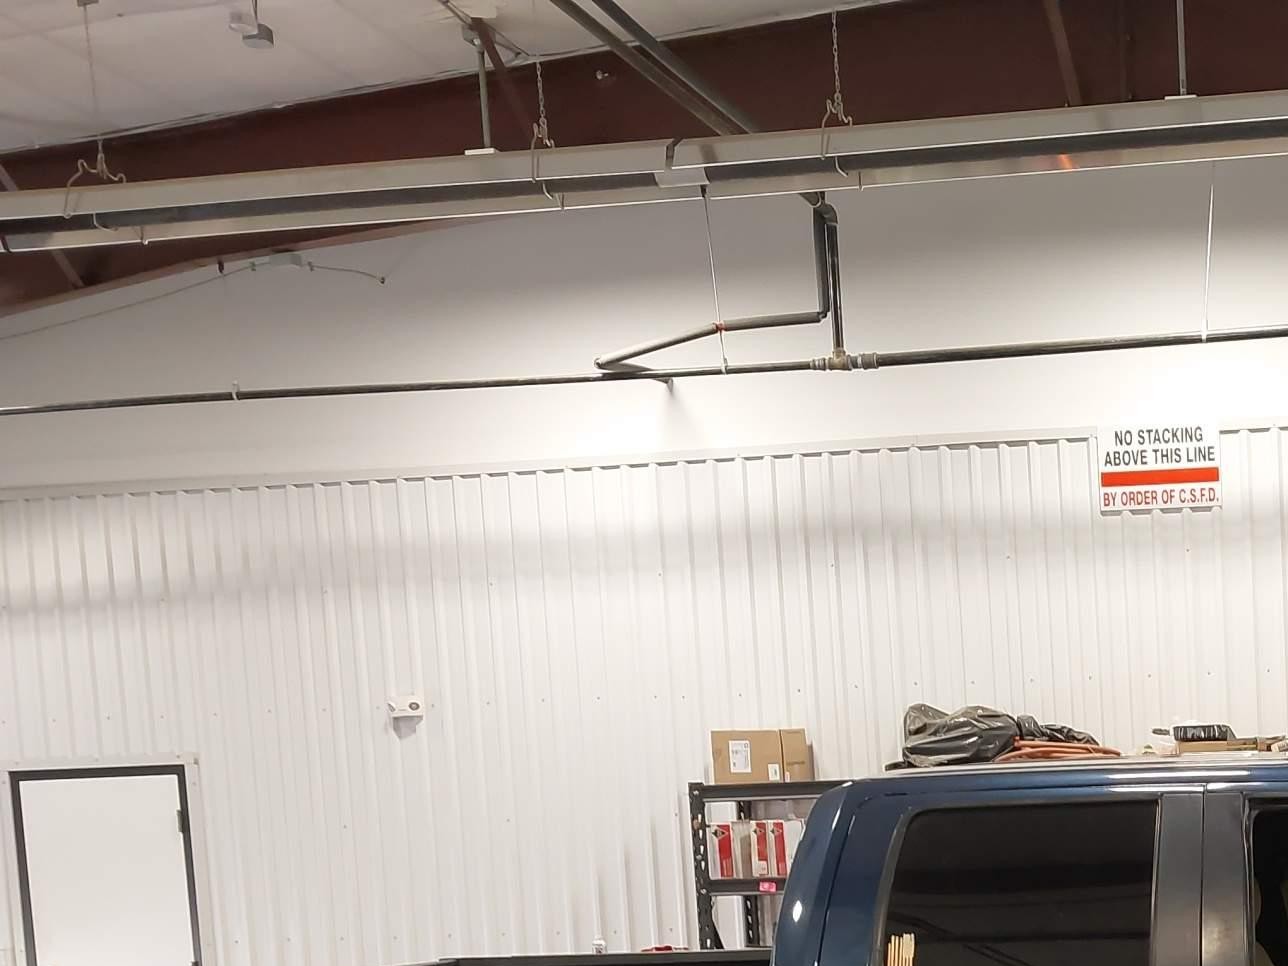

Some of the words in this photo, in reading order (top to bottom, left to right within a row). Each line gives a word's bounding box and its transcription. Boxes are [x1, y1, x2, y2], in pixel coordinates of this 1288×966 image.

[1114, 430, 1133, 446] NO
[1137, 426, 1204, 445] STACKING
[1104, 450, 1148, 466] ABOVE
[1152, 448, 1182, 464] THIS
[1186, 446, 1216, 463] LINE
[1103, 492, 1117, 507] BY
[1121, 489, 1158, 506] ORDER
[1161, 488, 1176, 504] OF
[1179, 487, 1220, 503] C.S.F.D.
